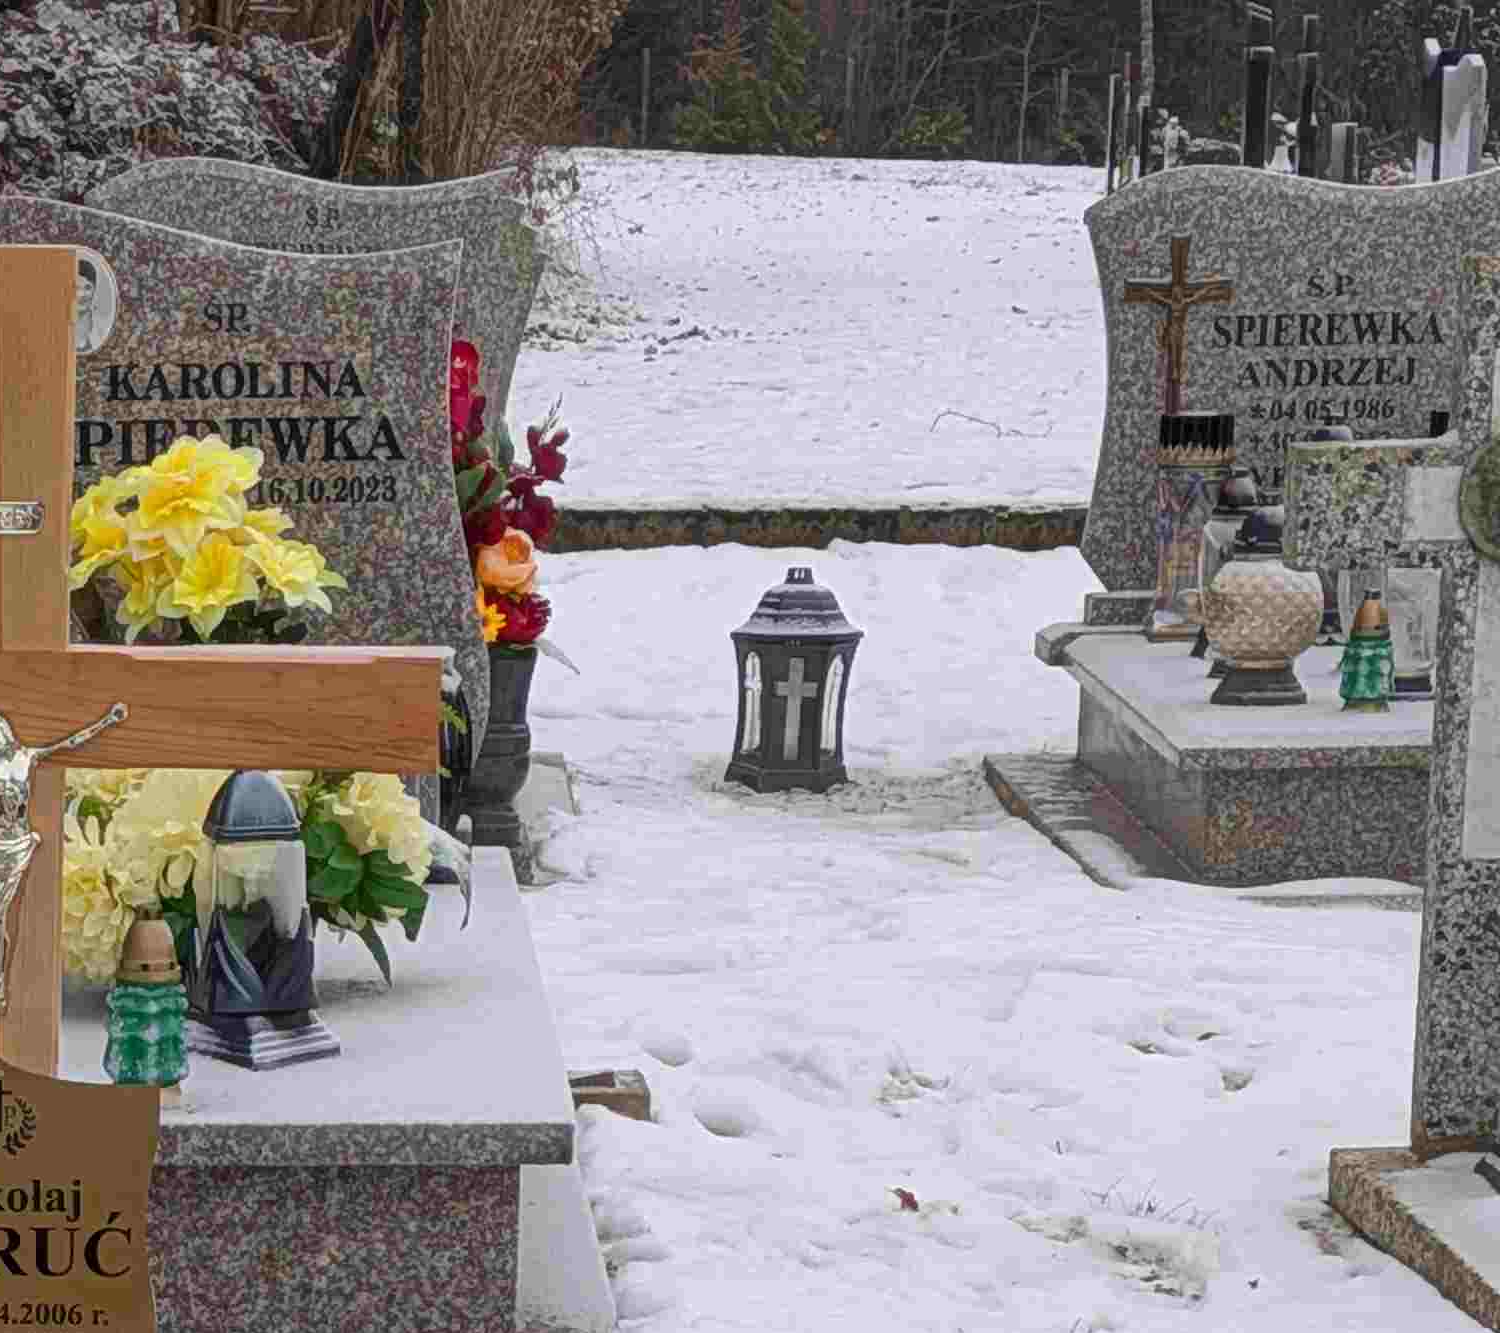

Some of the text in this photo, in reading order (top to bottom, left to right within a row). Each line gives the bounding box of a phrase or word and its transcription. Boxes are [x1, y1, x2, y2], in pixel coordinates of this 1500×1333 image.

[1211, 312, 1446, 347] SPIEREWKA
[104, 359, 366, 401] KAROLINA
[1238, 357, 1417, 387] ANDRZEJ
[75, 413, 405, 466] PIEEWKA
[91, 1307, 109, 1327] r.
